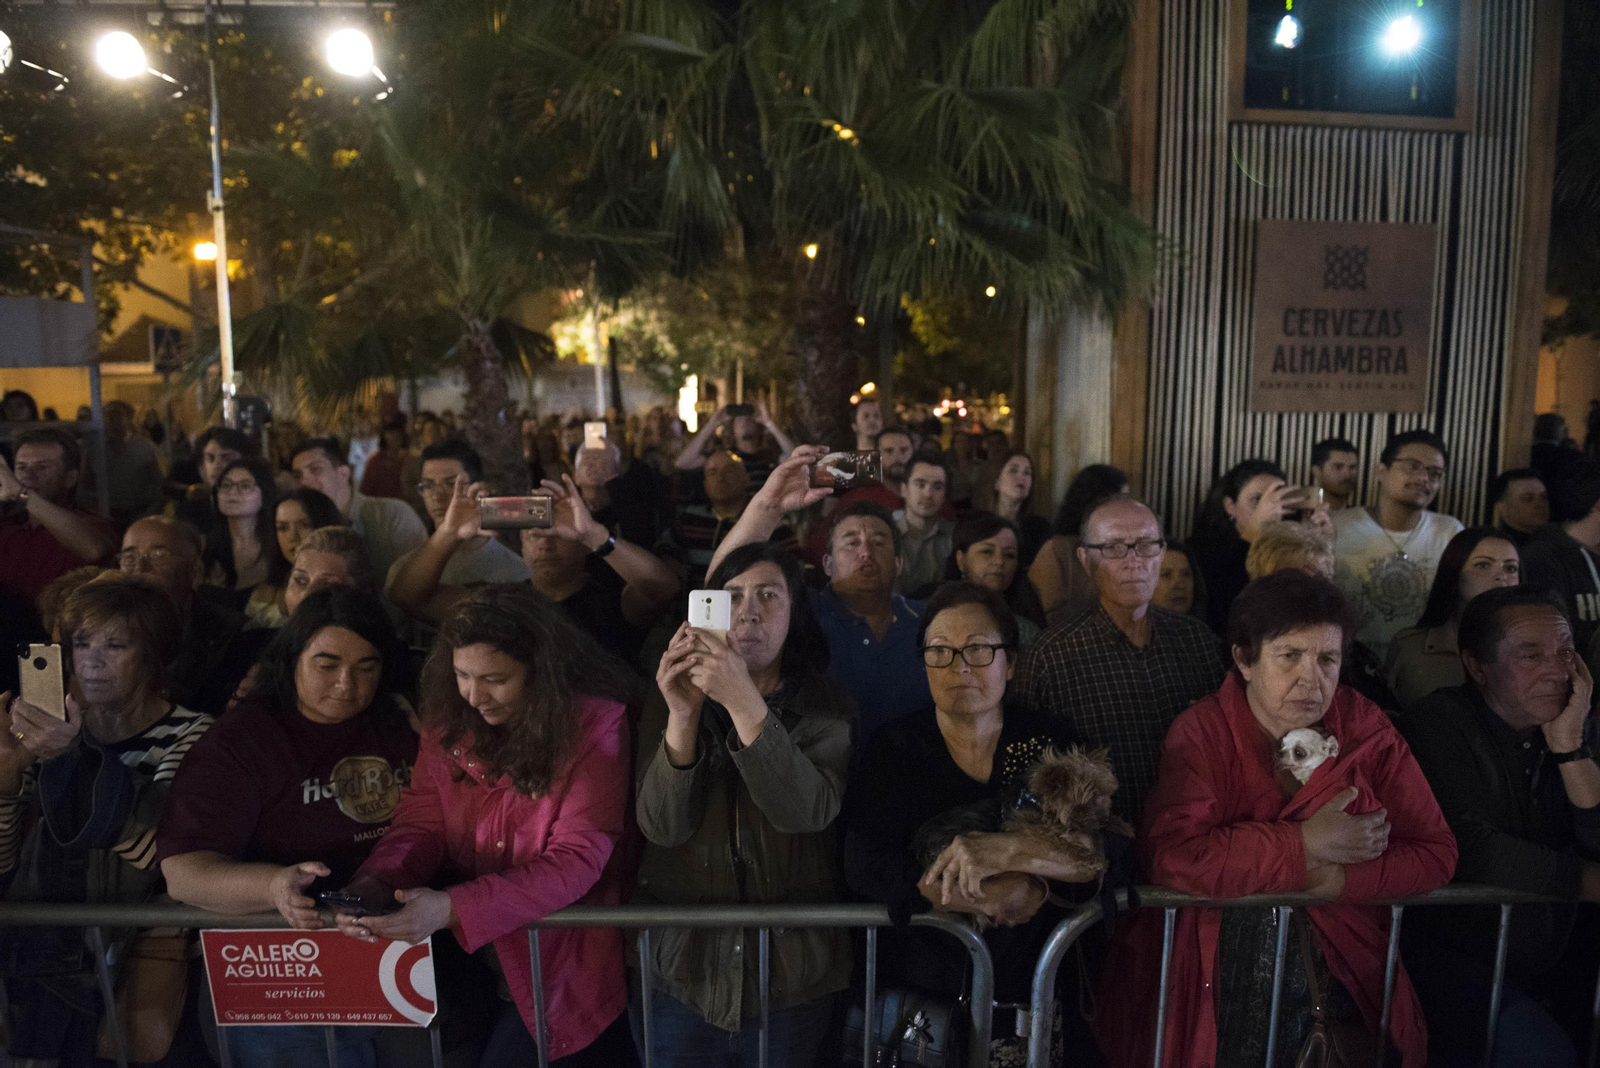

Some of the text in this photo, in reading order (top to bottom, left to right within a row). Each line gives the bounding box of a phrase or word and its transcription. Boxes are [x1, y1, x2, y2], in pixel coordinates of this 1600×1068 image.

[1282, 307, 1404, 338] CERVEZAS
[1272, 344, 1408, 375] ALHAMBRA
[300, 769, 360, 805] Hard
[356, 798, 387, 814] CAFE
[221, 938, 320, 963] CALERO
[224, 963, 322, 978] AGUILERA
[265, 987, 326, 999] servicios
